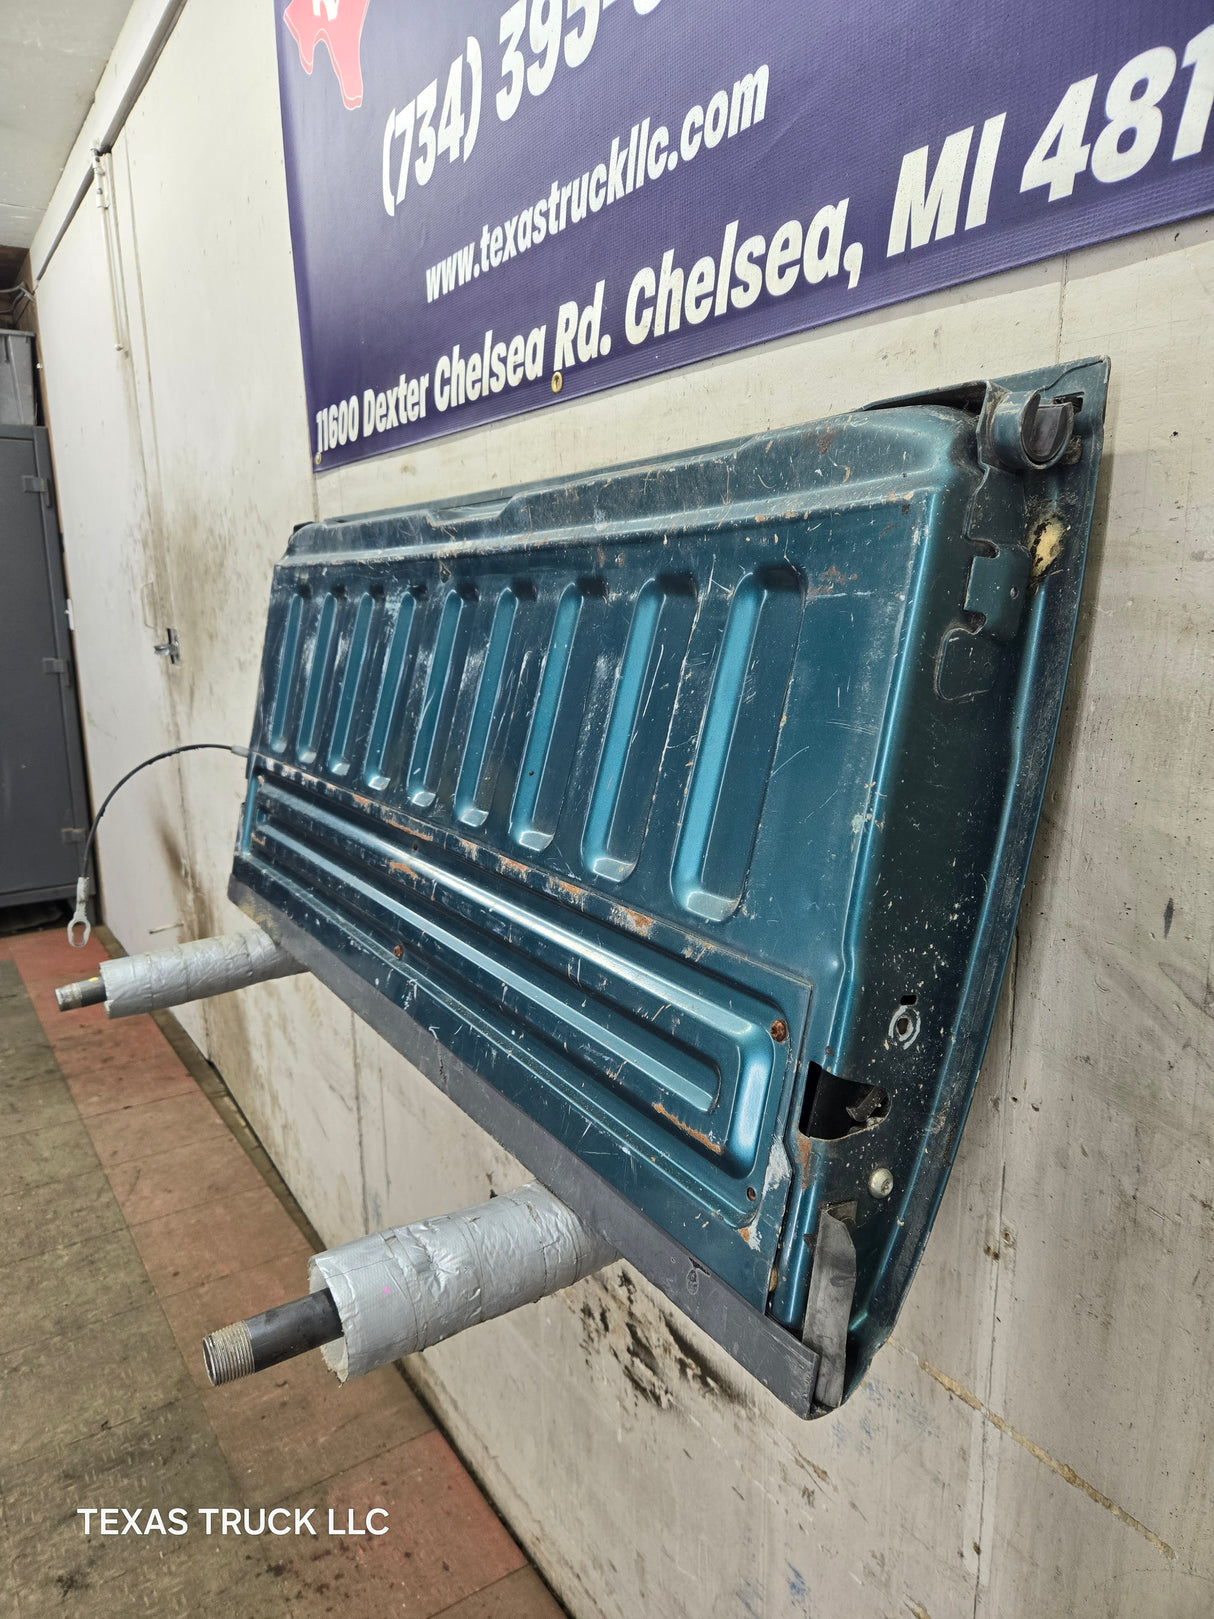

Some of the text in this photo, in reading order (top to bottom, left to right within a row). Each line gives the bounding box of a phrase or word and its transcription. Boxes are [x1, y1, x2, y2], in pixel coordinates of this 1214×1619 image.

[382, 0, 663, 217] (734) 395-
[426, 64, 770, 303] www.texastruckllc.com
[316, 395, 359, 453] 11600
[364, 373, 429, 437] Dexter
[434, 325, 546, 412] Chelsea
[554, 281, 612, 372] Rd.
[625, 197, 863, 345] Chelsea,
[886, 112, 1007, 257] MI
